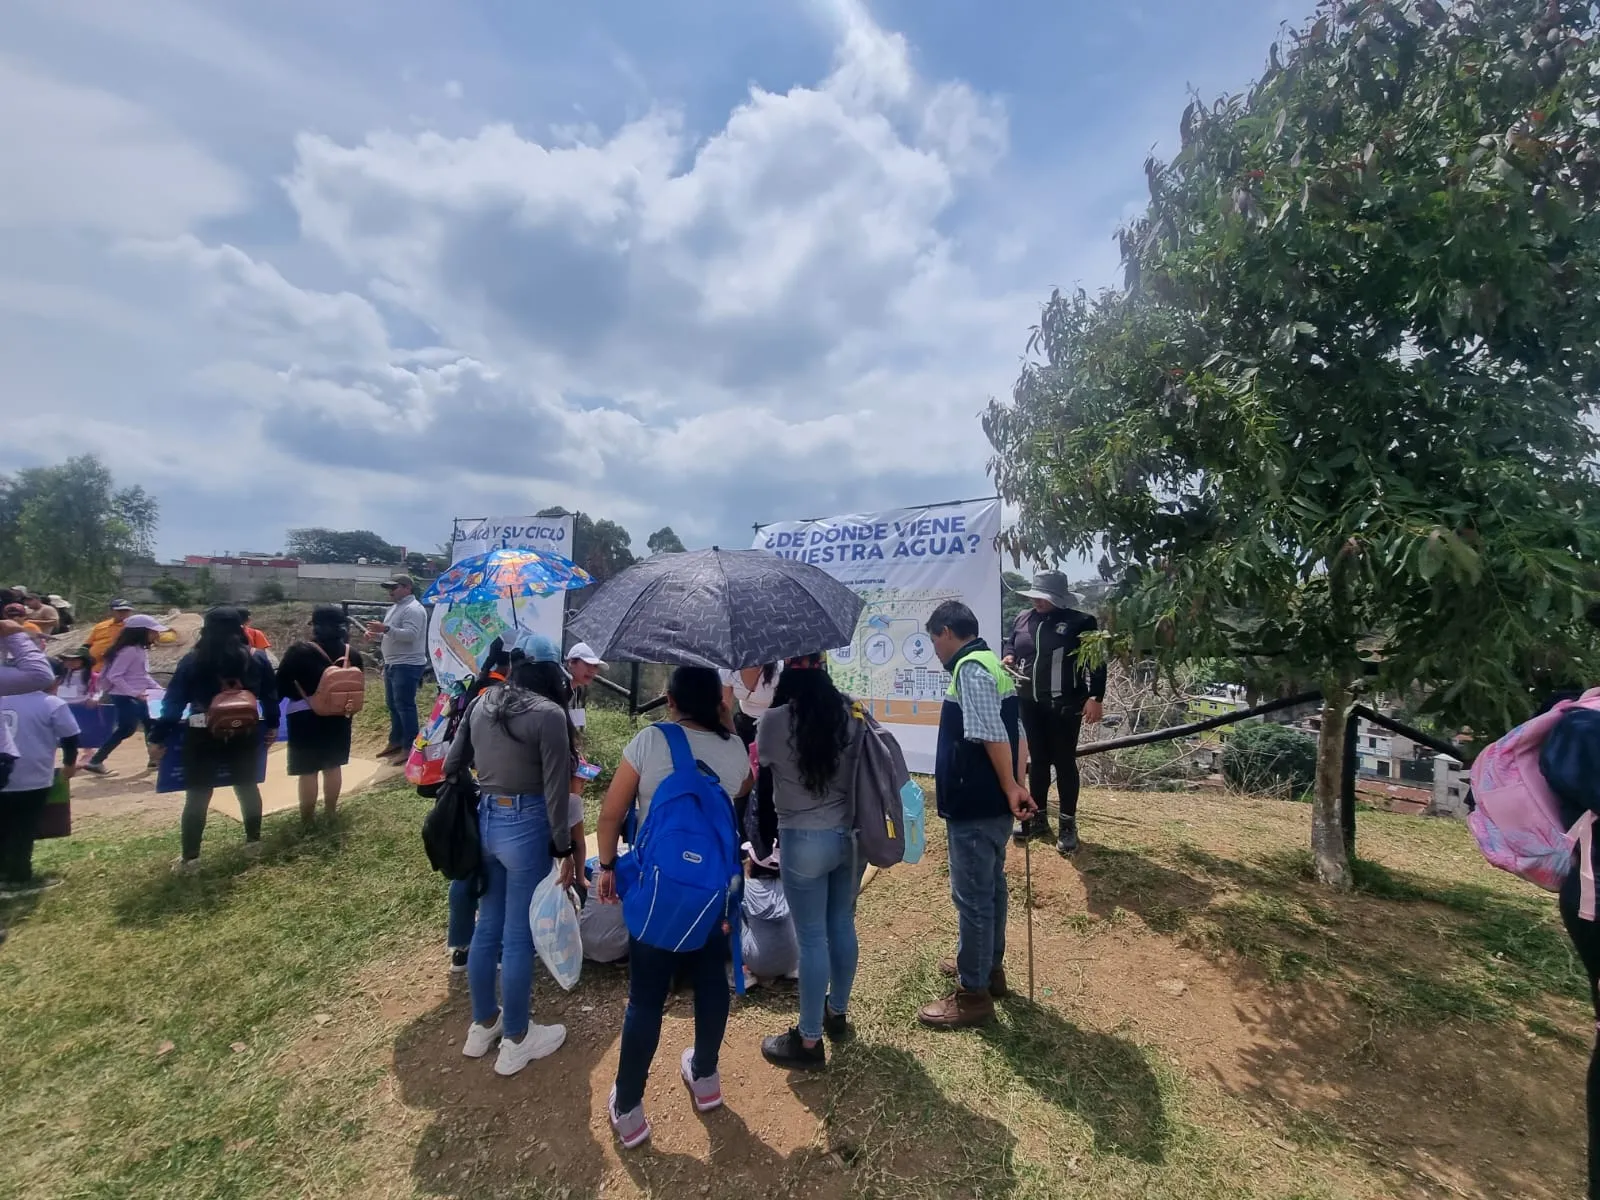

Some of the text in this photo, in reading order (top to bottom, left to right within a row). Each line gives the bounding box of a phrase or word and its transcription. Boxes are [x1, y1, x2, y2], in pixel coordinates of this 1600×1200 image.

[502, 526, 524, 540] SU
[525, 525, 565, 541] CICLO
[765, 516, 966, 549] ¿DE DÓNDE VIENE
[892, 534, 980, 558] AGUA?
